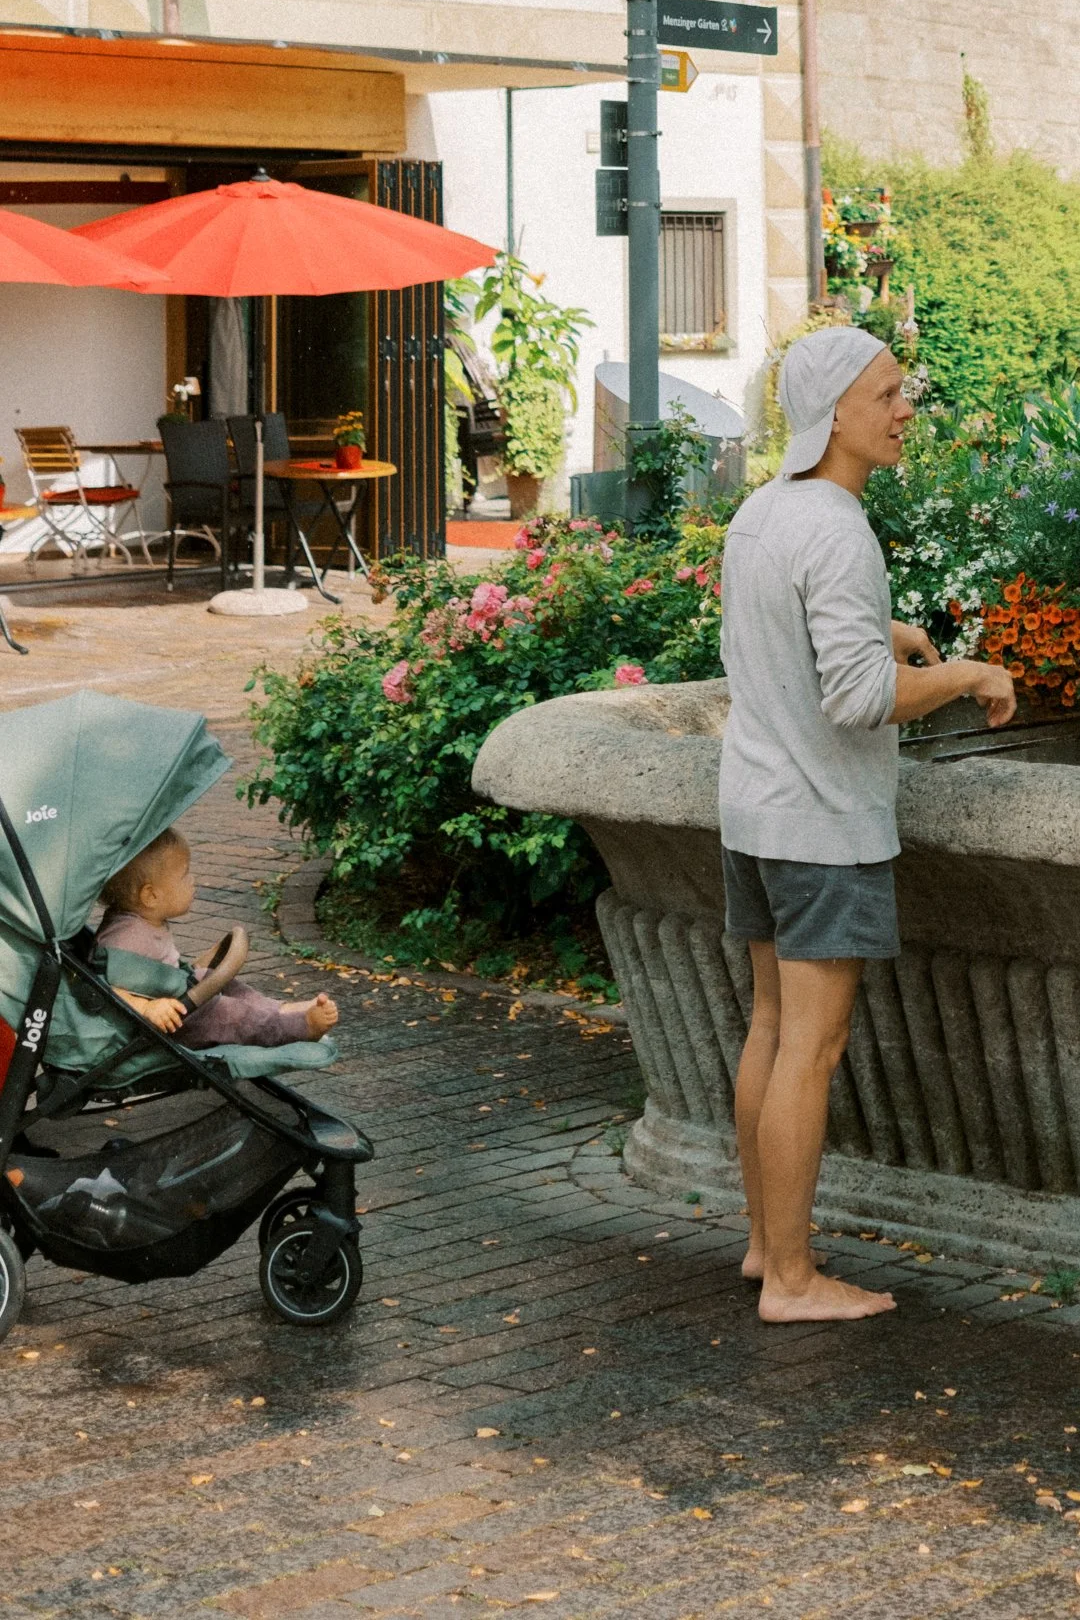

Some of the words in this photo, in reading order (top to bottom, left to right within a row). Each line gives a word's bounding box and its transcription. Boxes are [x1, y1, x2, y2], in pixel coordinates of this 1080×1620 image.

[663, 15, 697, 30] Menzinger
[697, 18, 720, 31] Gärten
[25, 804, 58, 824] Joie
[21, 1008, 48, 1053] Joie
